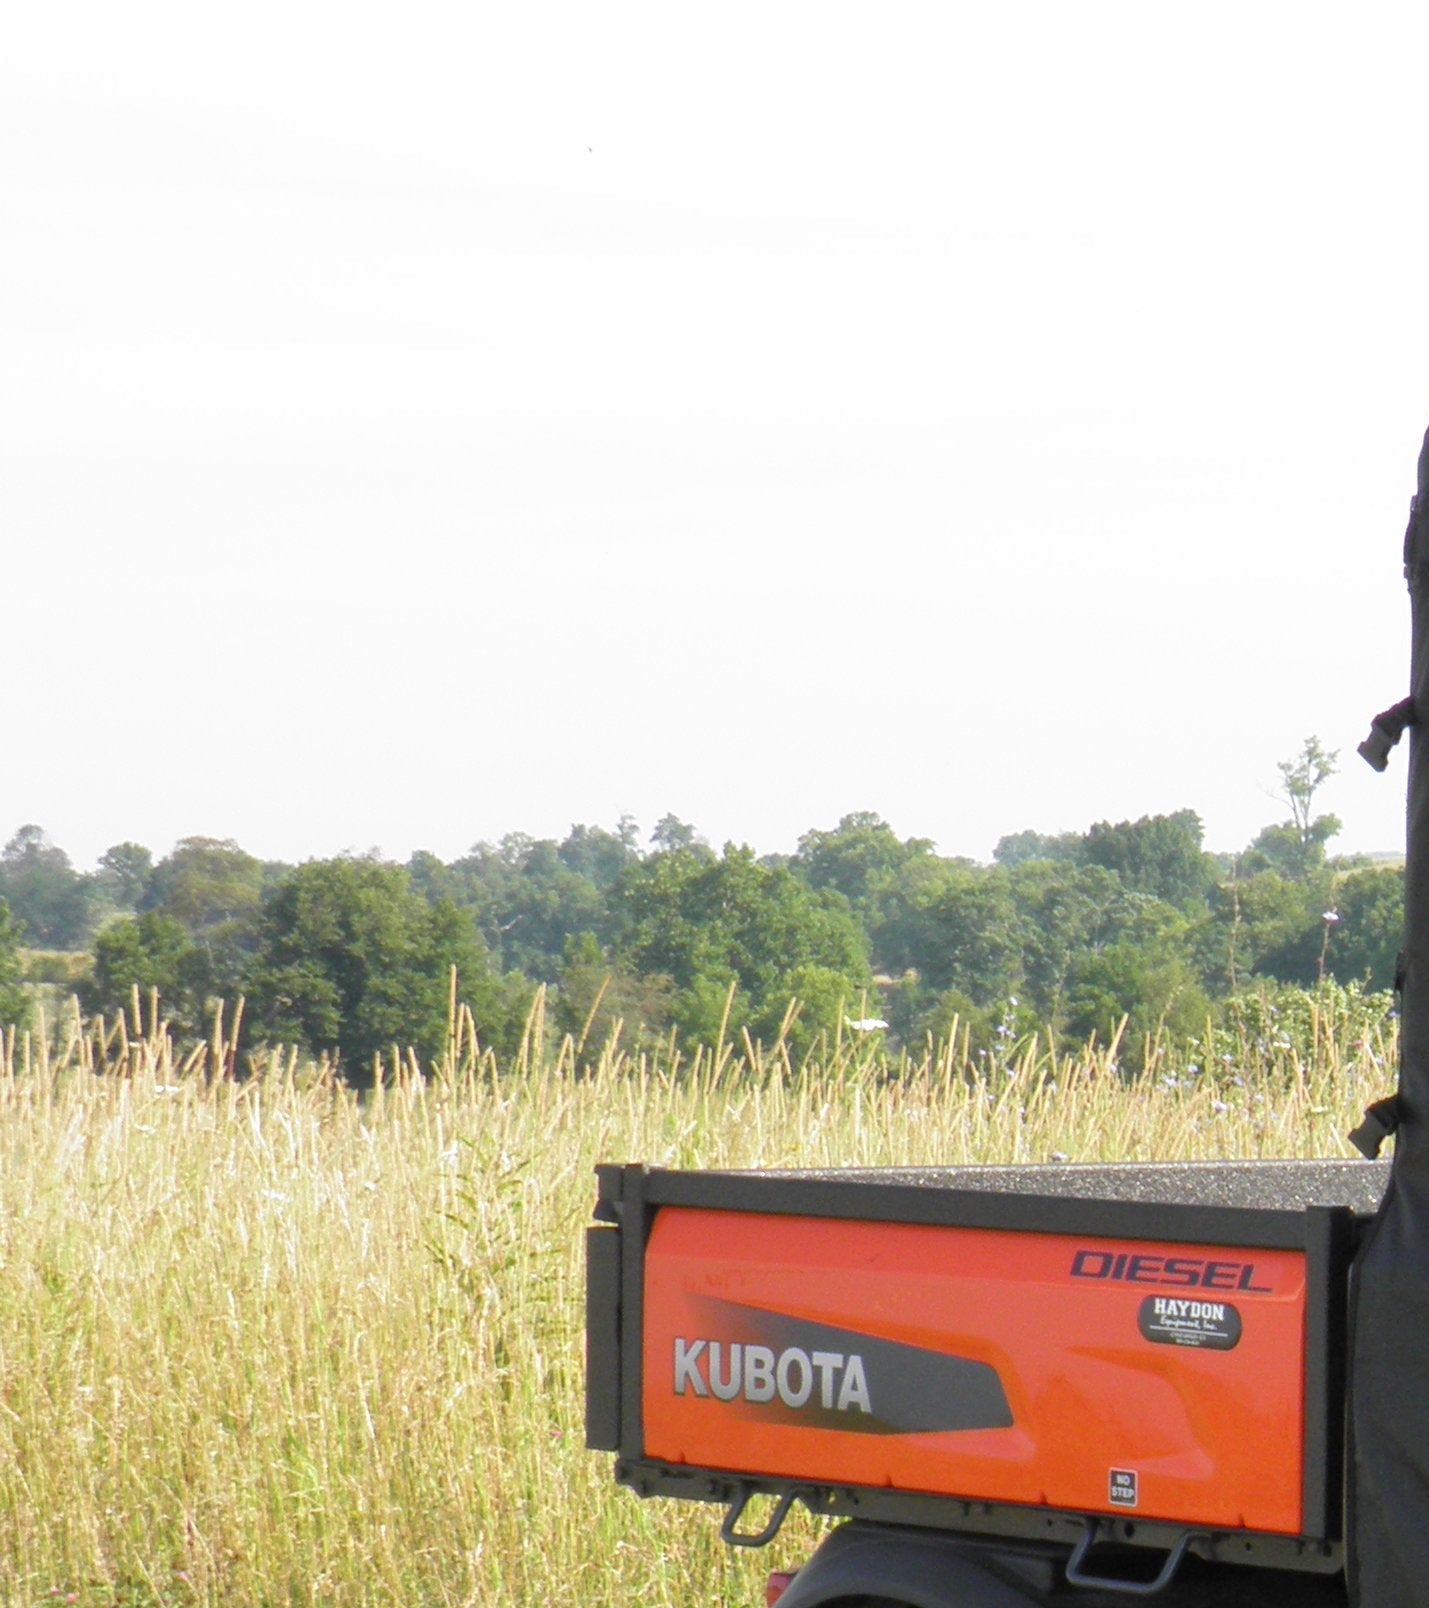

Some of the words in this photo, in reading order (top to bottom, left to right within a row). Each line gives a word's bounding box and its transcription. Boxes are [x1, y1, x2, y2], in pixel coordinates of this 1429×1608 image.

[1070, 1250, 1273, 1293] DIESEL
[1153, 1298, 1225, 1321] HAYDON
[674, 1337, 872, 1413] KUBOTA
[1111, 1485, 1135, 1498] STEP
[1116, 1474, 1131, 1486] NO
